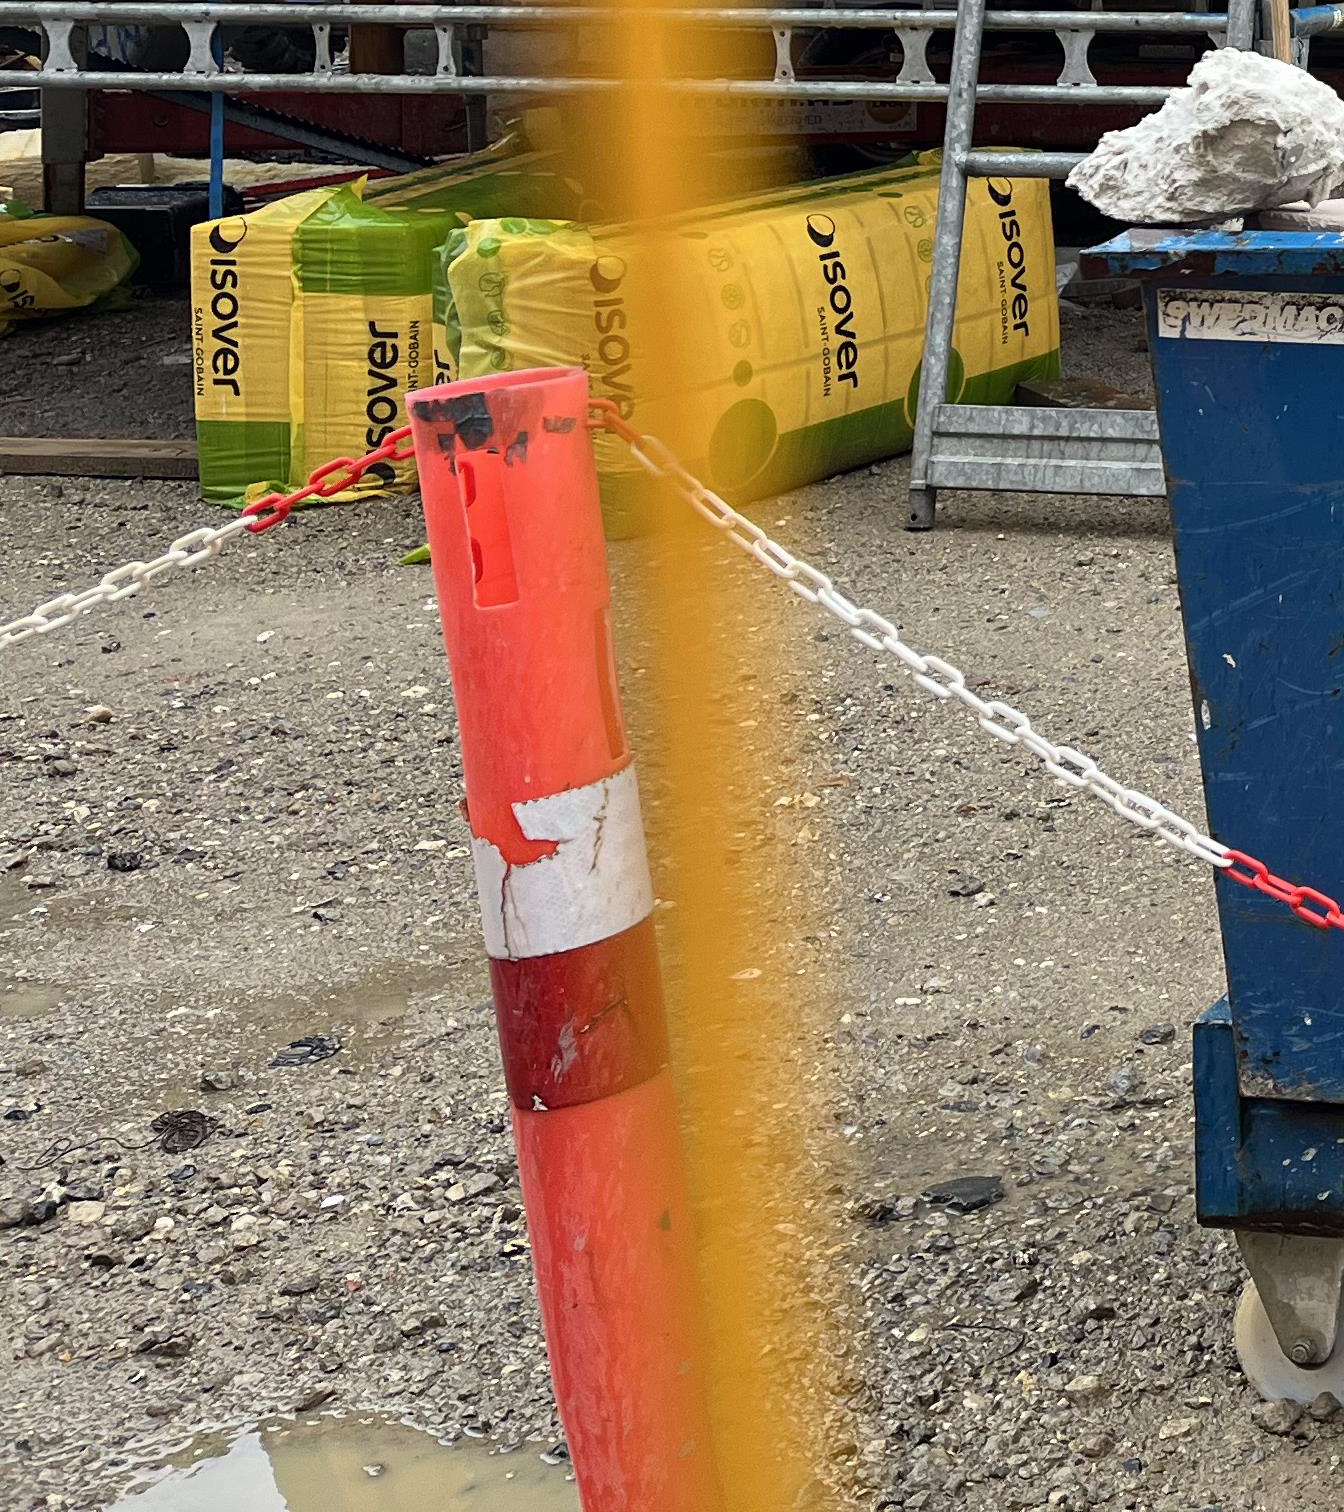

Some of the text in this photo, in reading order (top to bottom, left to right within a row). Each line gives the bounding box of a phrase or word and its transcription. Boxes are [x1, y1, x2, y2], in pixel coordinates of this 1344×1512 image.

[996, 260, 1009, 345] SAINT-GOBAIN
[193, 306, 205, 397] SAINT-GOBAIN
[365, 320, 400, 456] sover
[407, 320, 420, 393] NT-GOBAIN
[816, 306, 832, 398] SAINT-GOBAIN
